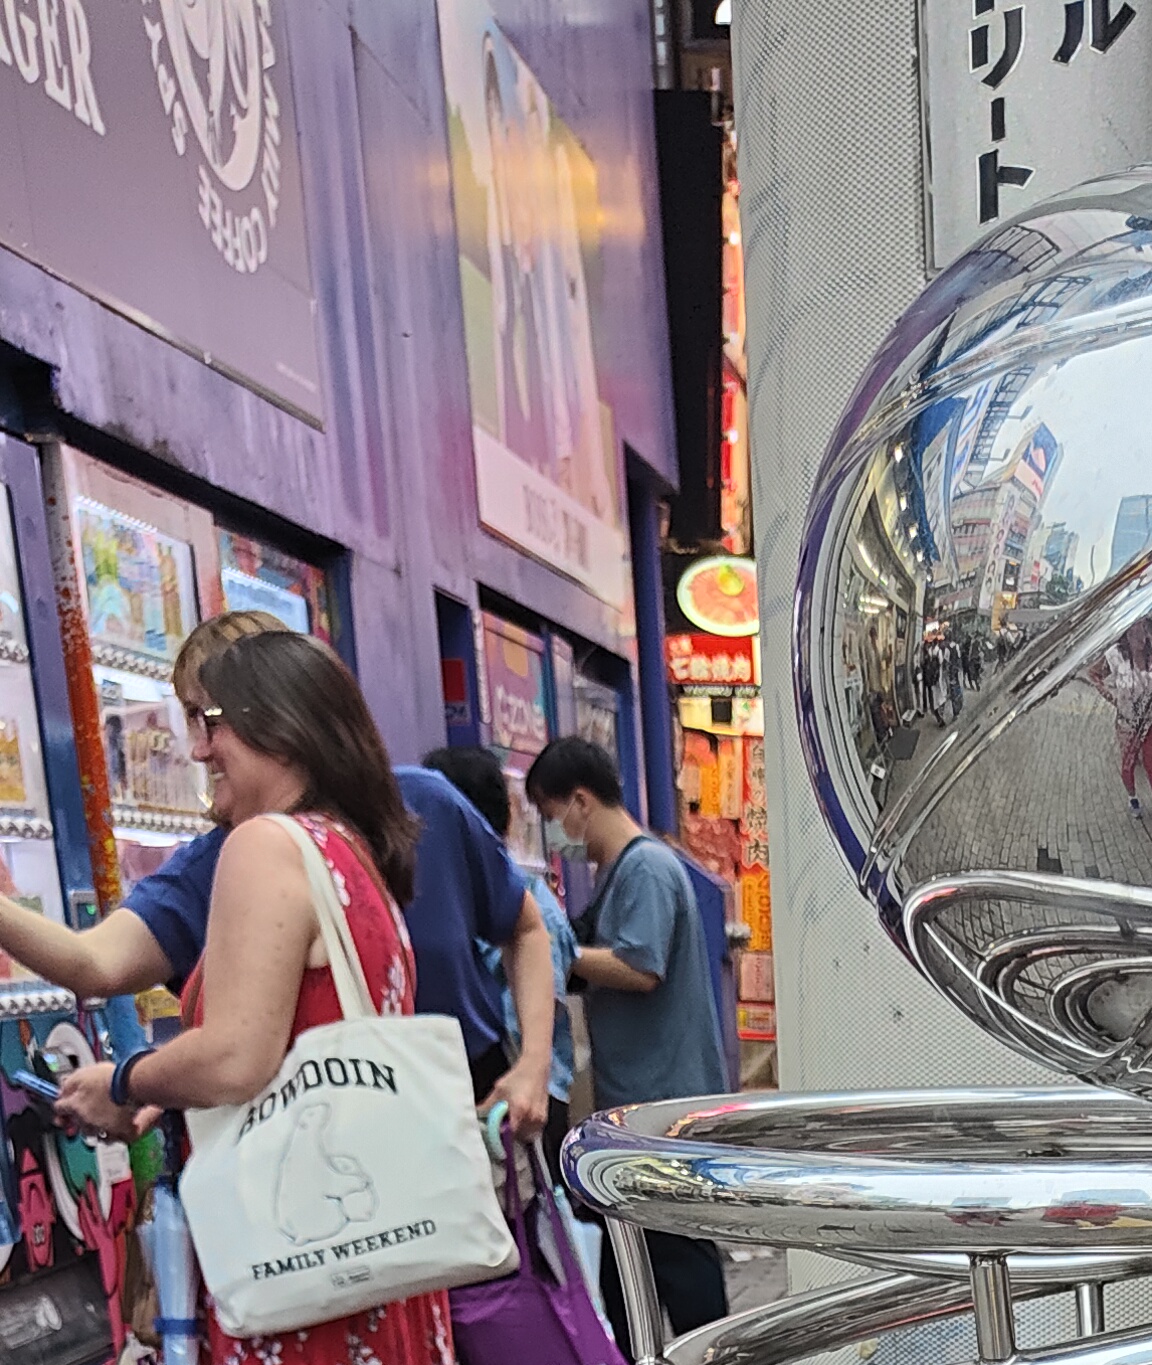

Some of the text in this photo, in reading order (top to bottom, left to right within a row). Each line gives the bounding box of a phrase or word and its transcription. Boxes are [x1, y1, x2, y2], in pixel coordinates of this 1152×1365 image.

[0, 0, 106, 136] GER
[968, 0, 1035, 225] リート
[198, 164, 268, 273] COFFEE
[233, 1057, 400, 1146] BOWDOIN
[251, 1248, 326, 1281] FAMILY
[330, 1219, 437, 1262] WEEKEND
